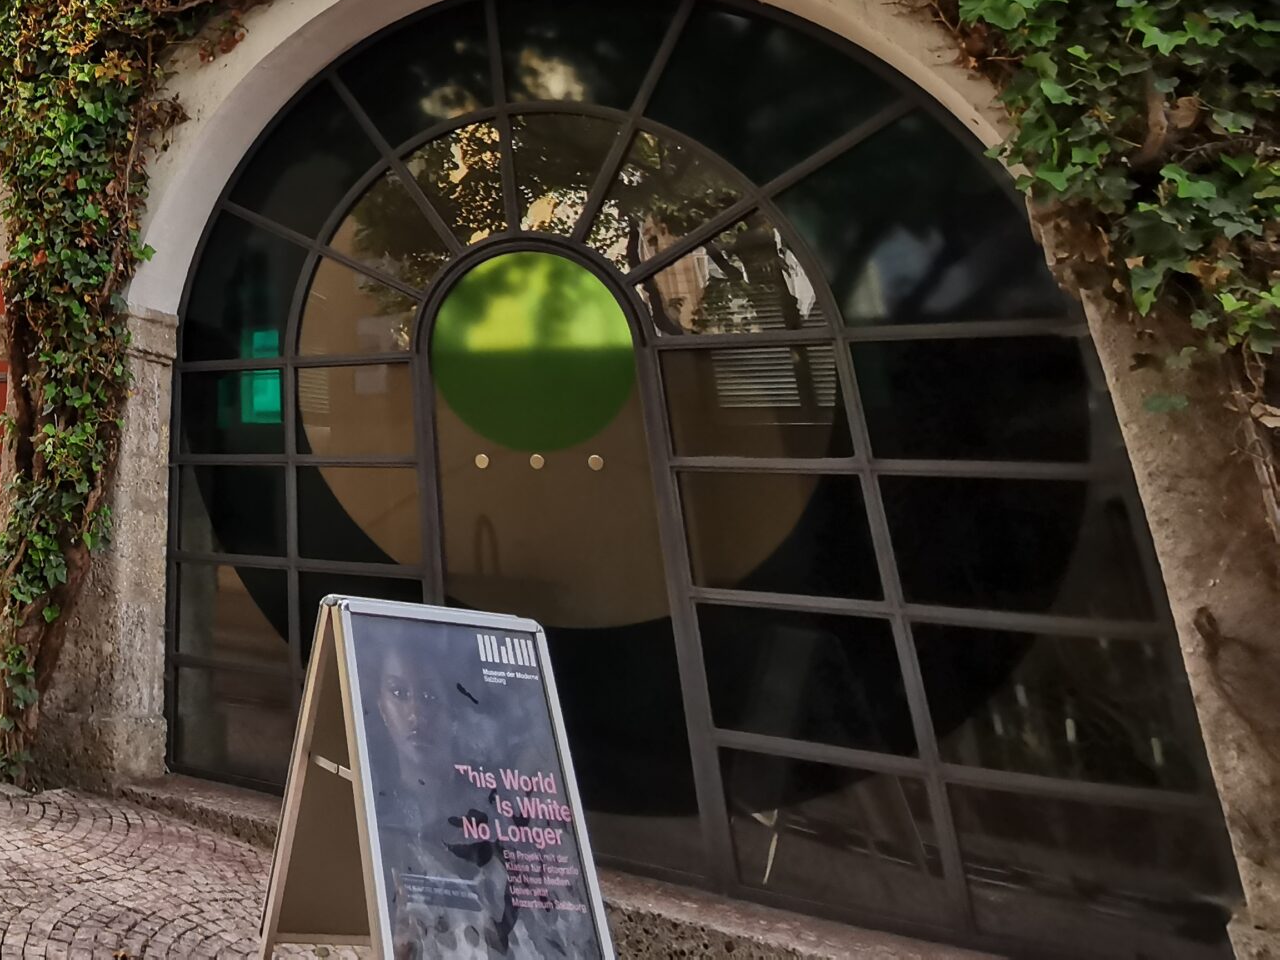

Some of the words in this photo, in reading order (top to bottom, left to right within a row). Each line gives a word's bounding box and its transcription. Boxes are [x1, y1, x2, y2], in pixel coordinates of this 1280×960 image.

[454, 764, 497, 789] This
[499, 768, 557, 794] World
[495, 794, 514, 818] Is
[516, 796, 572, 823] White
[462, 816, 491, 840] No
[495, 819, 563, 850] Longer
